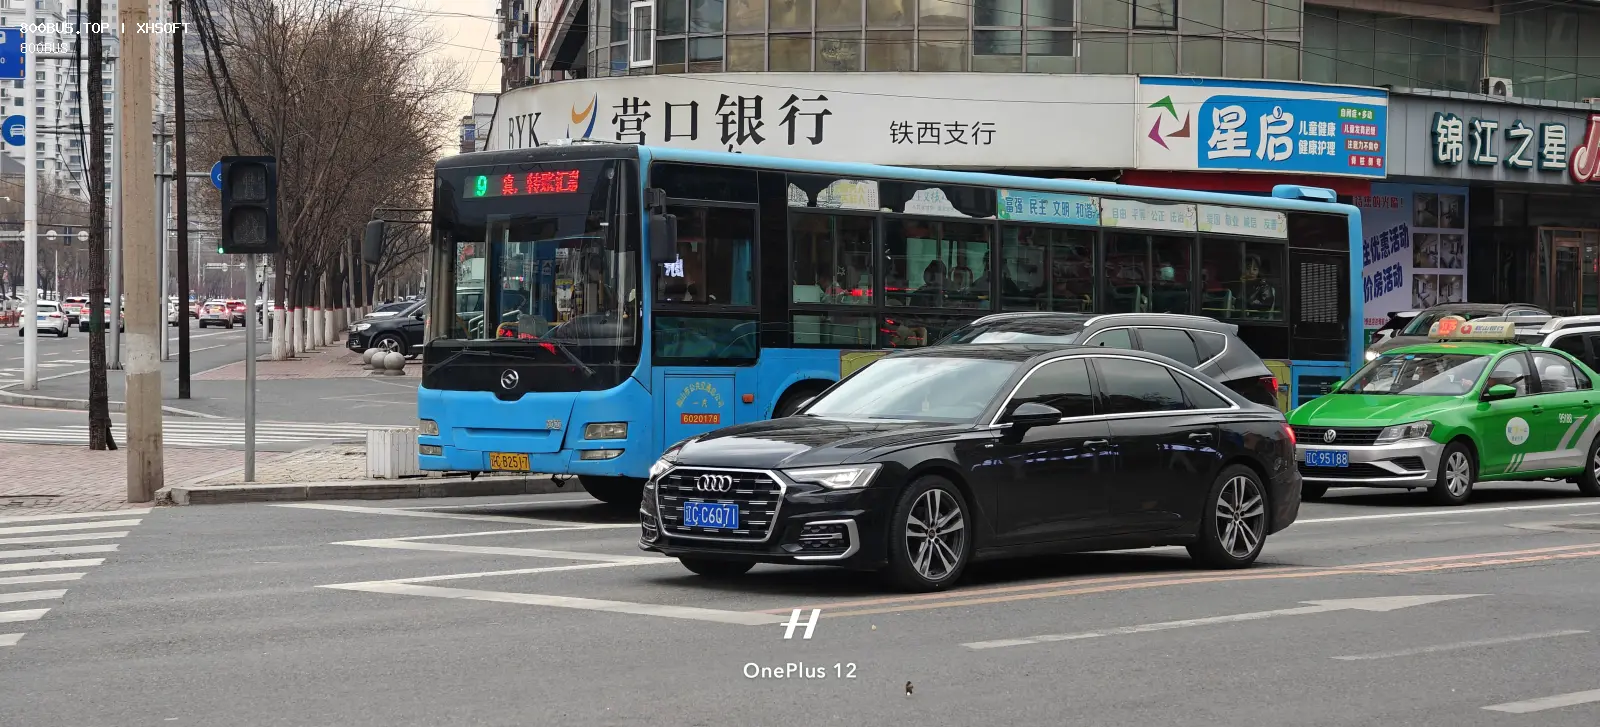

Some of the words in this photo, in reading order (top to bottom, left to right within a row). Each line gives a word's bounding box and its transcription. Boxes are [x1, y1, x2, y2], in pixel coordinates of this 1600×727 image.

[508, 112, 542, 149] BYK
[611, 93, 833, 146] 营口银行
[1298, 120, 1336, 137] 儿童健康
[889, 120, 997, 145] 铁西支行
[1207, 105, 1295, 162] 星启
[1432, 113, 1567, 171] 锦江之星
[1298, 139, 1336, 156] 健康护理
[477, 175, 487, 196] 9
[1005, 196, 1023, 214] 富强
[1029, 198, 1047, 216] 民主
[1052, 200, 1070, 217] 文明
[1075, 202, 1093, 219] 和谐
[1112, 207, 1127, 220] 自由
[1151, 210, 1165, 222] 公正
[1363, 262, 1403, 303] 价房活动
[683, 414, 718, 423] 6020178
[1558, 413, 1573, 423] 95188
